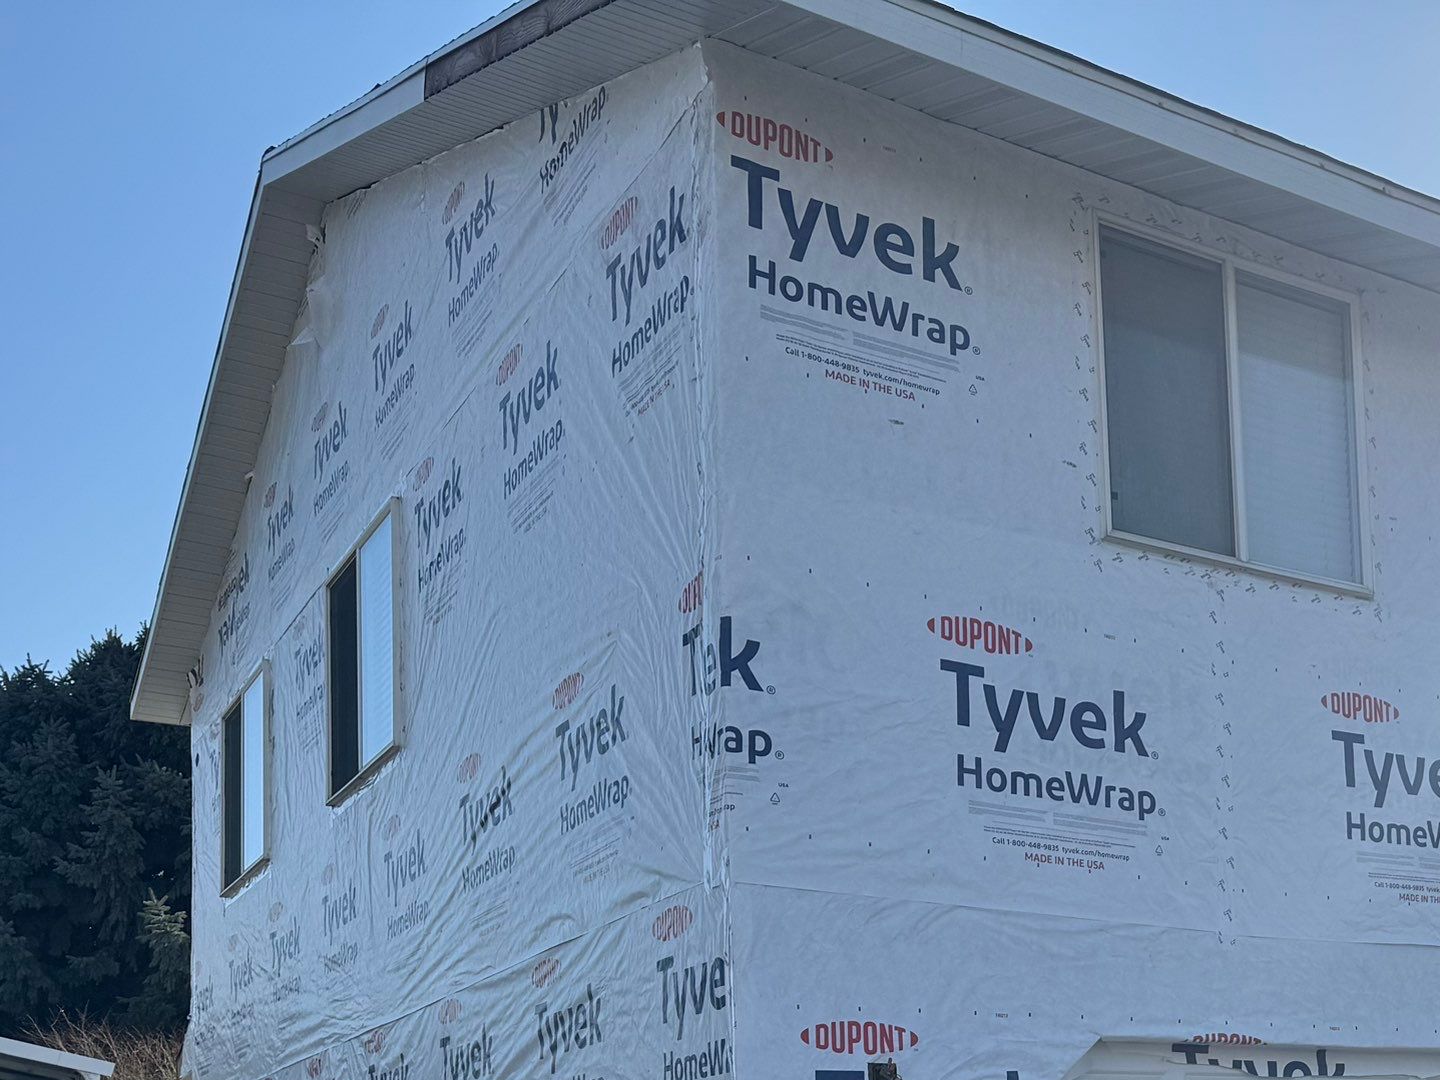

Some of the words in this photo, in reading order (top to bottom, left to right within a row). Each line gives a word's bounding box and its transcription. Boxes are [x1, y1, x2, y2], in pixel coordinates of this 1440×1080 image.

[731, 110, 821, 163] DUPONT
[445, 172, 495, 284] Tyvek
[606, 186, 686, 327] Tyvek
[731, 155, 963, 292] Tyvek
[449, 243, 497, 328] HomeWrap
[749, 255, 971, 355] HomeWrap
[372, 300, 412, 396] Tyvek
[611, 276, 689, 378] HomeWrap
[500, 340, 559, 455] Tyvek
[785, 346, 800, 358] Call
[801, 349, 860, 373] 1-800-448-9835
[863, 368, 940, 396] tyvek.com/homewrap
[825, 369, 857, 386] MADE
[859, 378, 870, 390] IN
[873, 381, 893, 395] THE
[895, 388, 915, 401] USA
[313, 401, 347, 483] Tyvek
[504, 420, 562, 500] HomeWrap
[414, 457, 462, 555] Tyvek
[940, 616, 1022, 655] DUPONT
[555, 684, 626, 792] Tyvek
[940, 658, 1149, 757] Tyvek
[1331, 692, 1391, 723] DUPONT
[459, 765, 512, 855] Tyvek
[560, 775, 629, 835] HomeWrap
[957, 754, 1156, 821] HomeWrap
[384, 829, 426, 907] Tyvek
[462, 846, 515, 895] HomeWrap
[992, 837, 1005, 846] Call
[1006, 839, 1059, 852] 1-800-448-9835
[1062, 846, 1130, 862] tyvek.com/homewrap
[1025, 852, 1052, 864] MADE
[1054, 856, 1065, 866] IN
[1066, 857, 1084, 868] THE
[1086, 860, 1105, 870] USA
[322, 878, 357, 946] Tyvek
[1399, 893, 1420, 903] MADE
[1421, 895, 1428, 903] IN
[535, 983, 601, 1074] Tyvek
[656, 956, 726, 1041] Tyve
[815, 1021, 906, 1055] DUPONT
